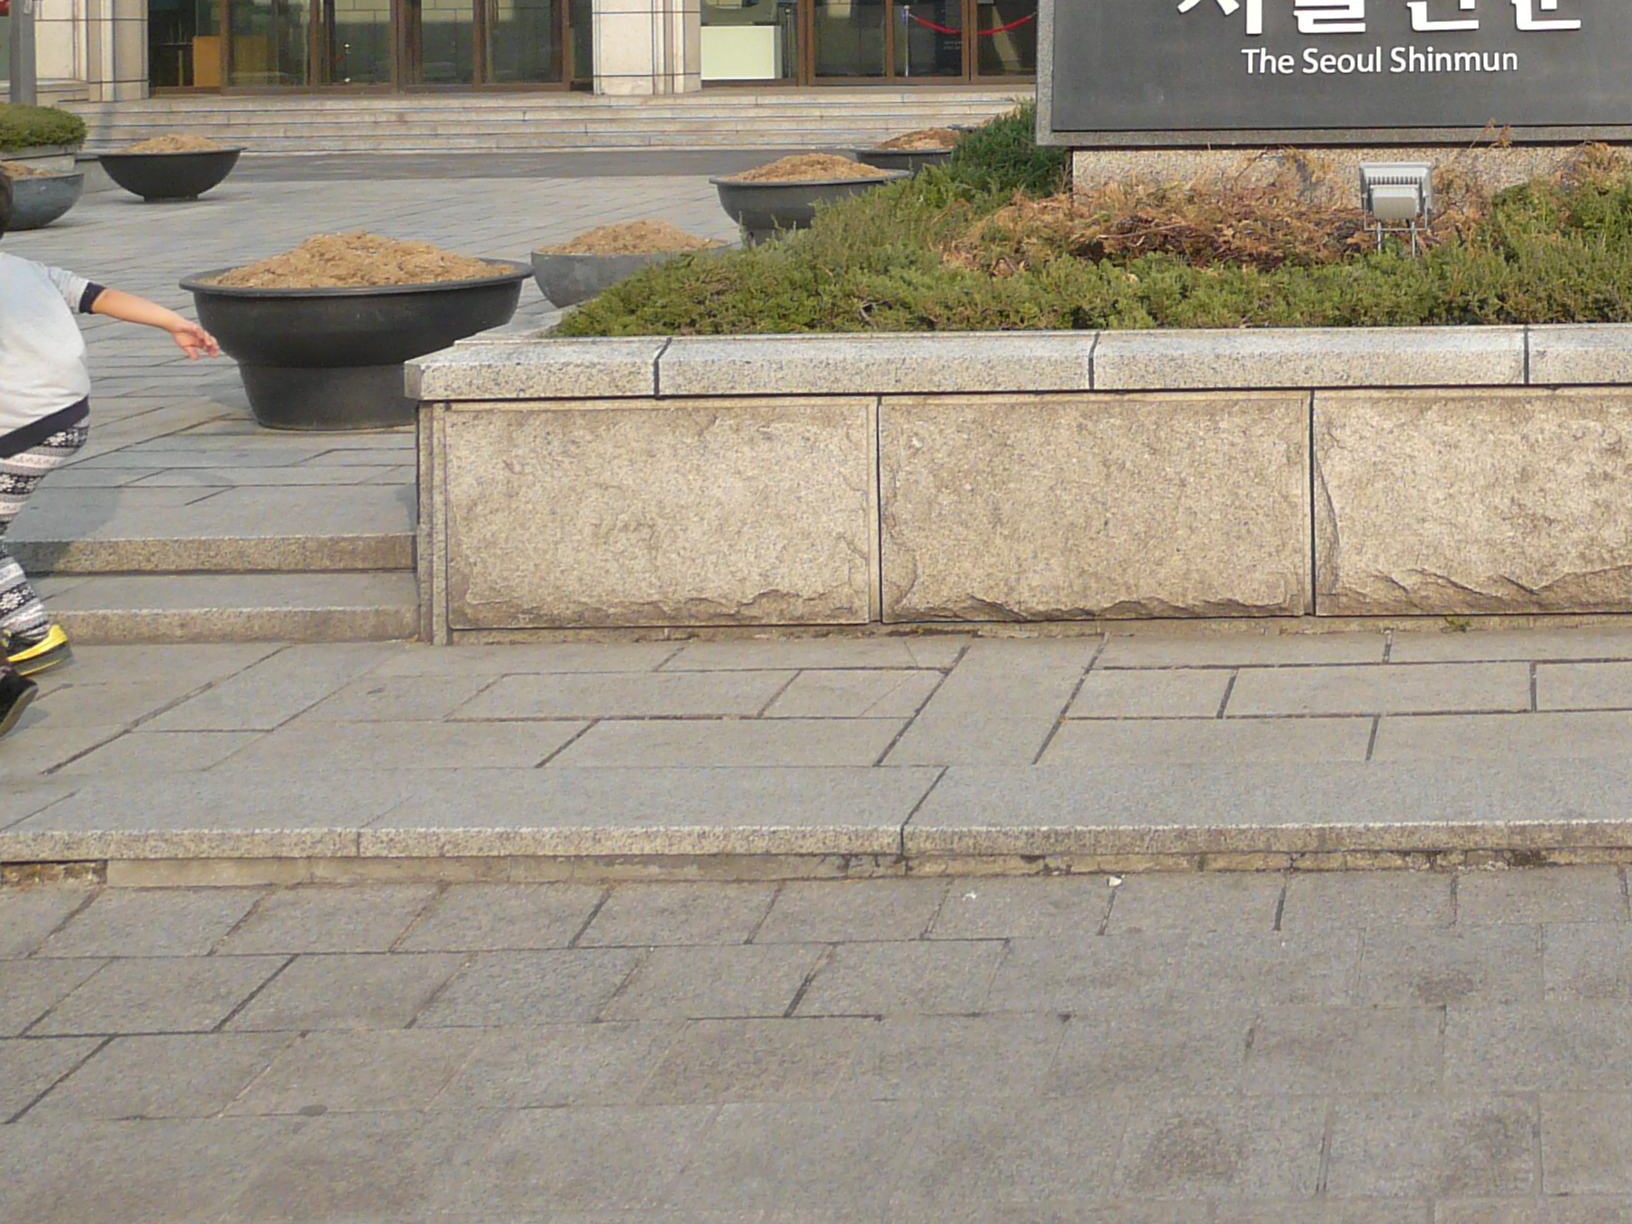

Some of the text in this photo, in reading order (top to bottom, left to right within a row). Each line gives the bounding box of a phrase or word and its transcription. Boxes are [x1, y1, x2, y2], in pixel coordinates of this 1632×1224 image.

[1242, 47, 1519, 75] The Seoul Shinmun
